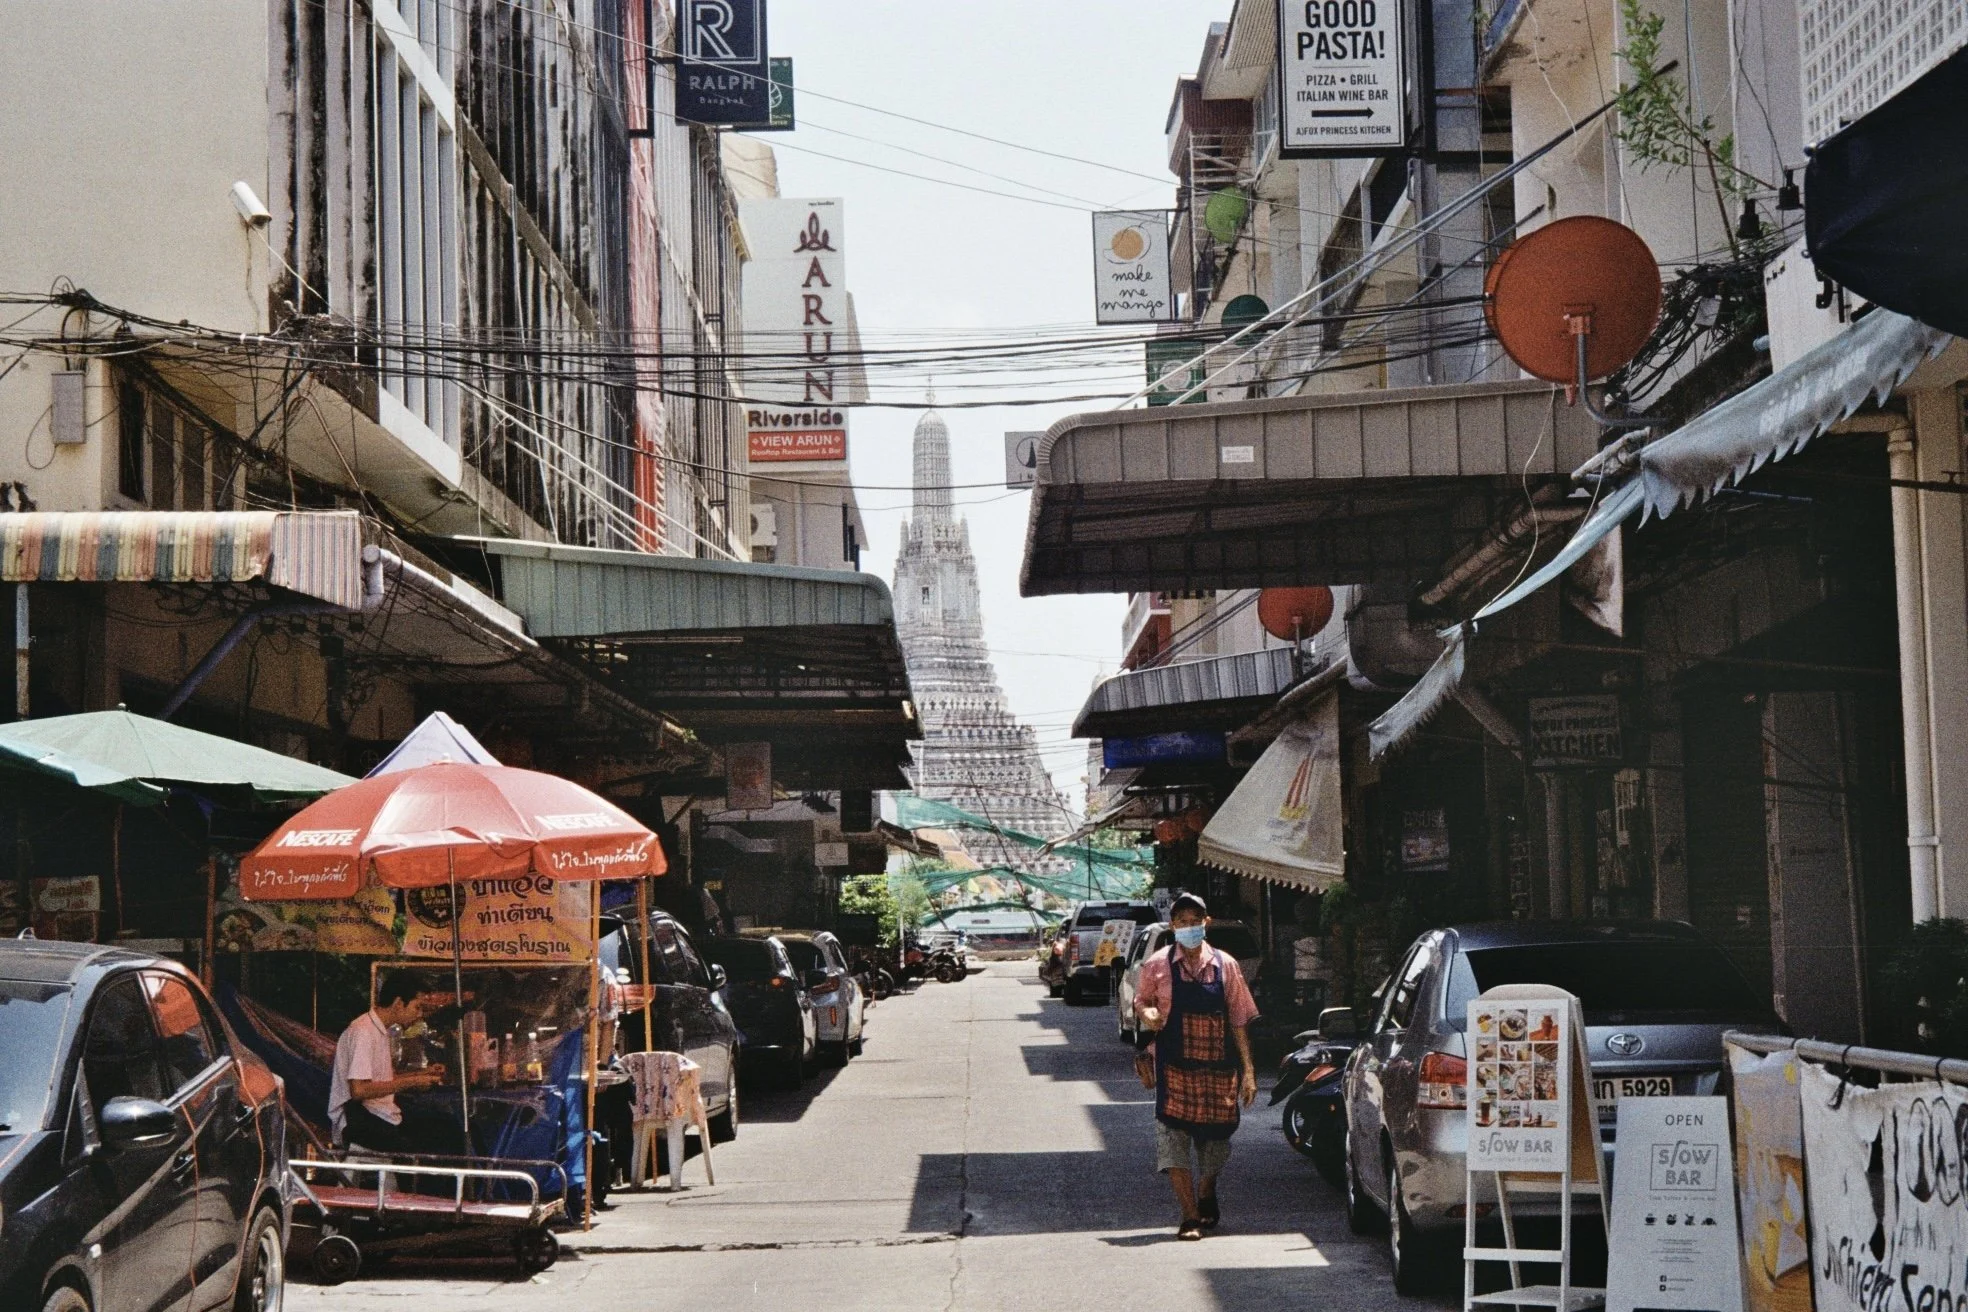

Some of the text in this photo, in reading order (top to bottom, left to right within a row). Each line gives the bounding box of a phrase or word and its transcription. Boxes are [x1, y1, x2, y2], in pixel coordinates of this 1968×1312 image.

[1304, 0, 1377, 29] GOOD
[687, 0, 737, 59] R
[1297, 30, 1386, 61] PASTA!
[688, 75, 755, 90] RALPH
[1306, 73, 1379, 86] PIZZA GRILL
[1296, 89, 1389, 102] ITALIAN WINE BAR
[1320, 125, 1359, 136] PRINCESS
[1359, 124, 1392, 135] KITCHEN
[1111, 264, 1154, 282] make
[1118, 287, 1149, 298] me
[1100, 299, 1166, 318] mango
[801, 255, 834, 402] ARUN
[748, 408, 844, 428] Riverside
[759, 434, 833, 447] VIEW ARUN
[828, 446, 842, 455] Bar
[1533, 733, 1621, 756] KITCHEN
[1621, 1078, 1672, 1097] 5929
[1664, 1114, 1704, 1126] OPEN
[1523, 1139, 1554, 1154] BAR
[1664, 1169, 1702, 1186] BAR
